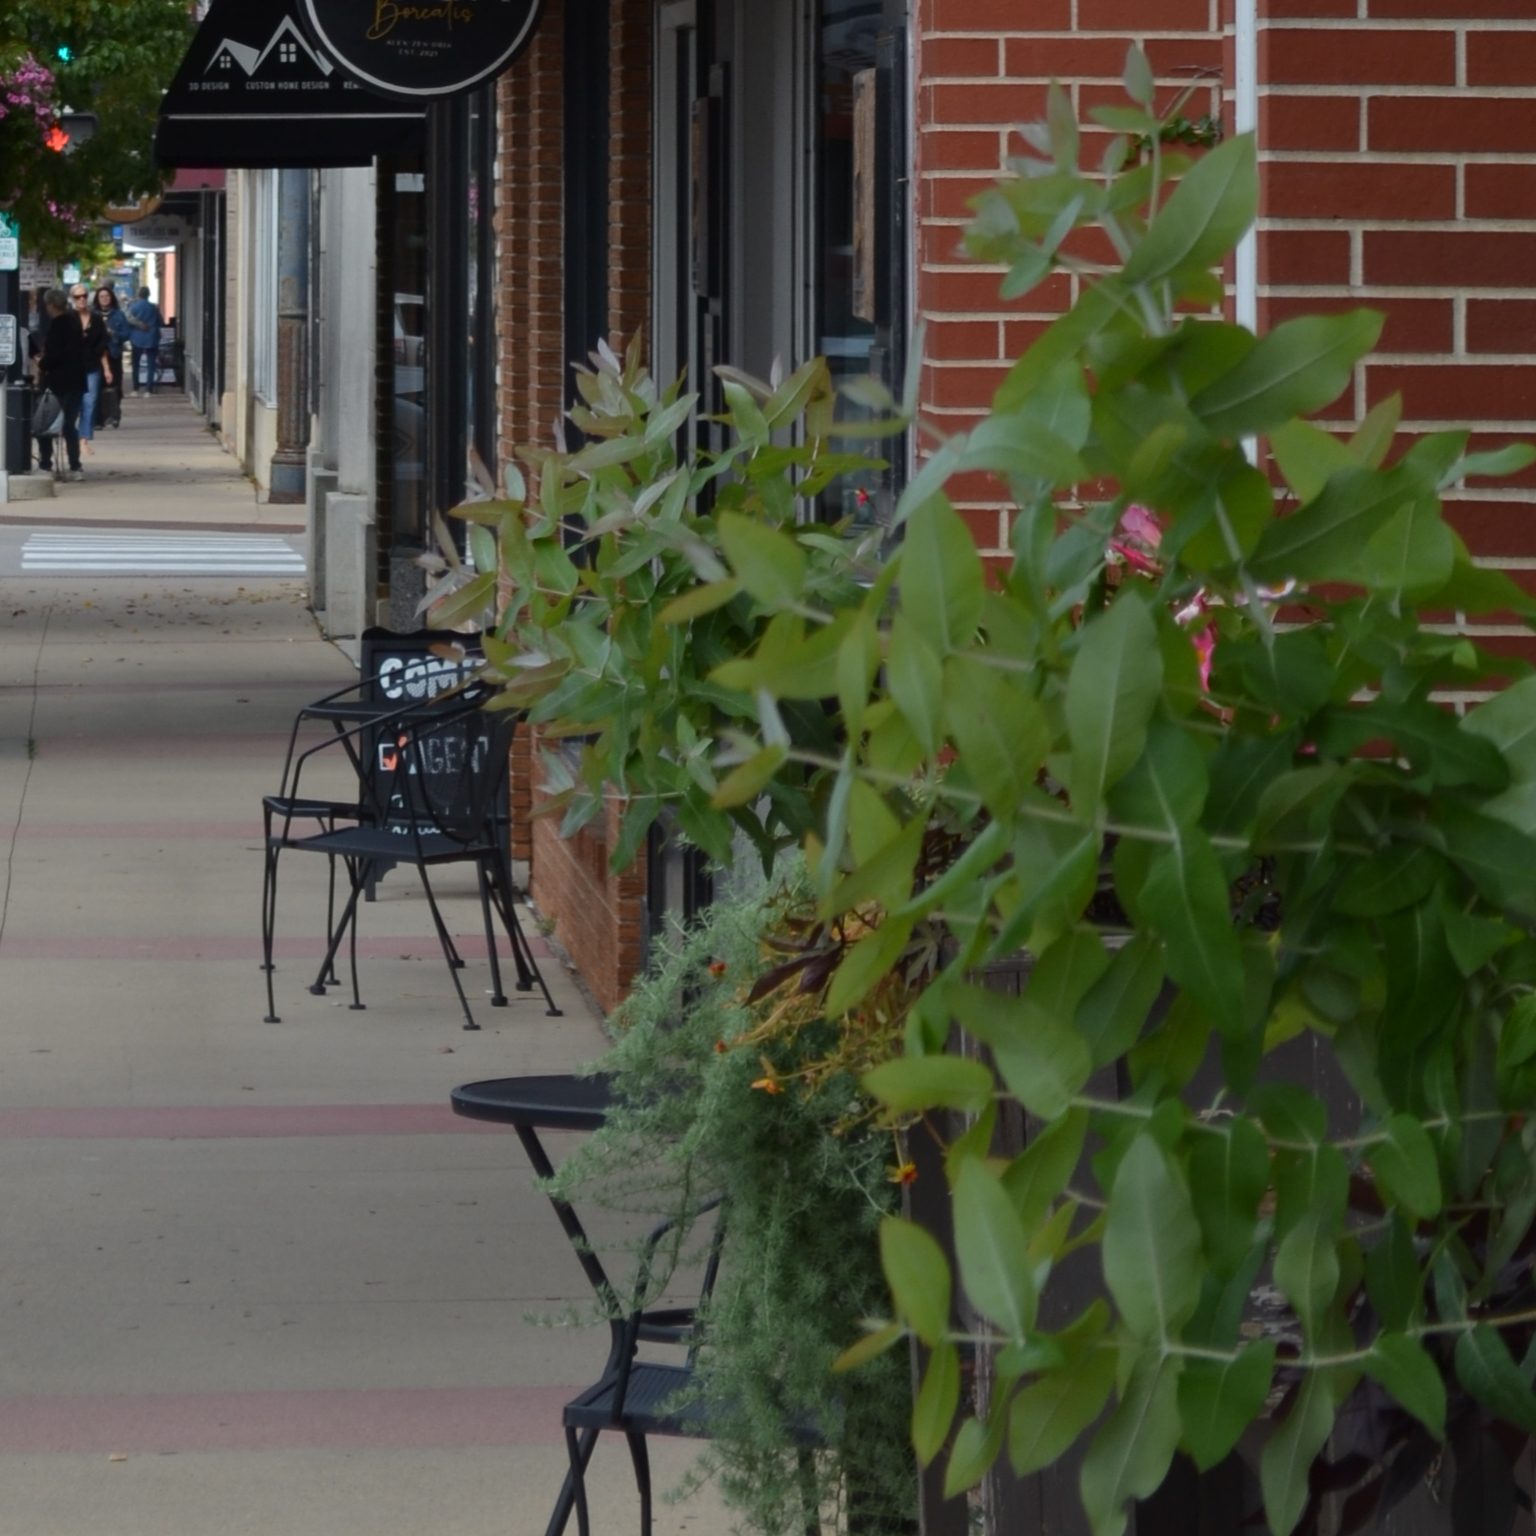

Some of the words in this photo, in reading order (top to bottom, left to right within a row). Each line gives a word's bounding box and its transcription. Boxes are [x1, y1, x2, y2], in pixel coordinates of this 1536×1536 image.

[202, 82, 230, 90] DESIGN
[245, 81, 275, 90] CUSTOM
[278, 81, 299, 90] HOME
[301, 81, 330, 90] DESIGN
